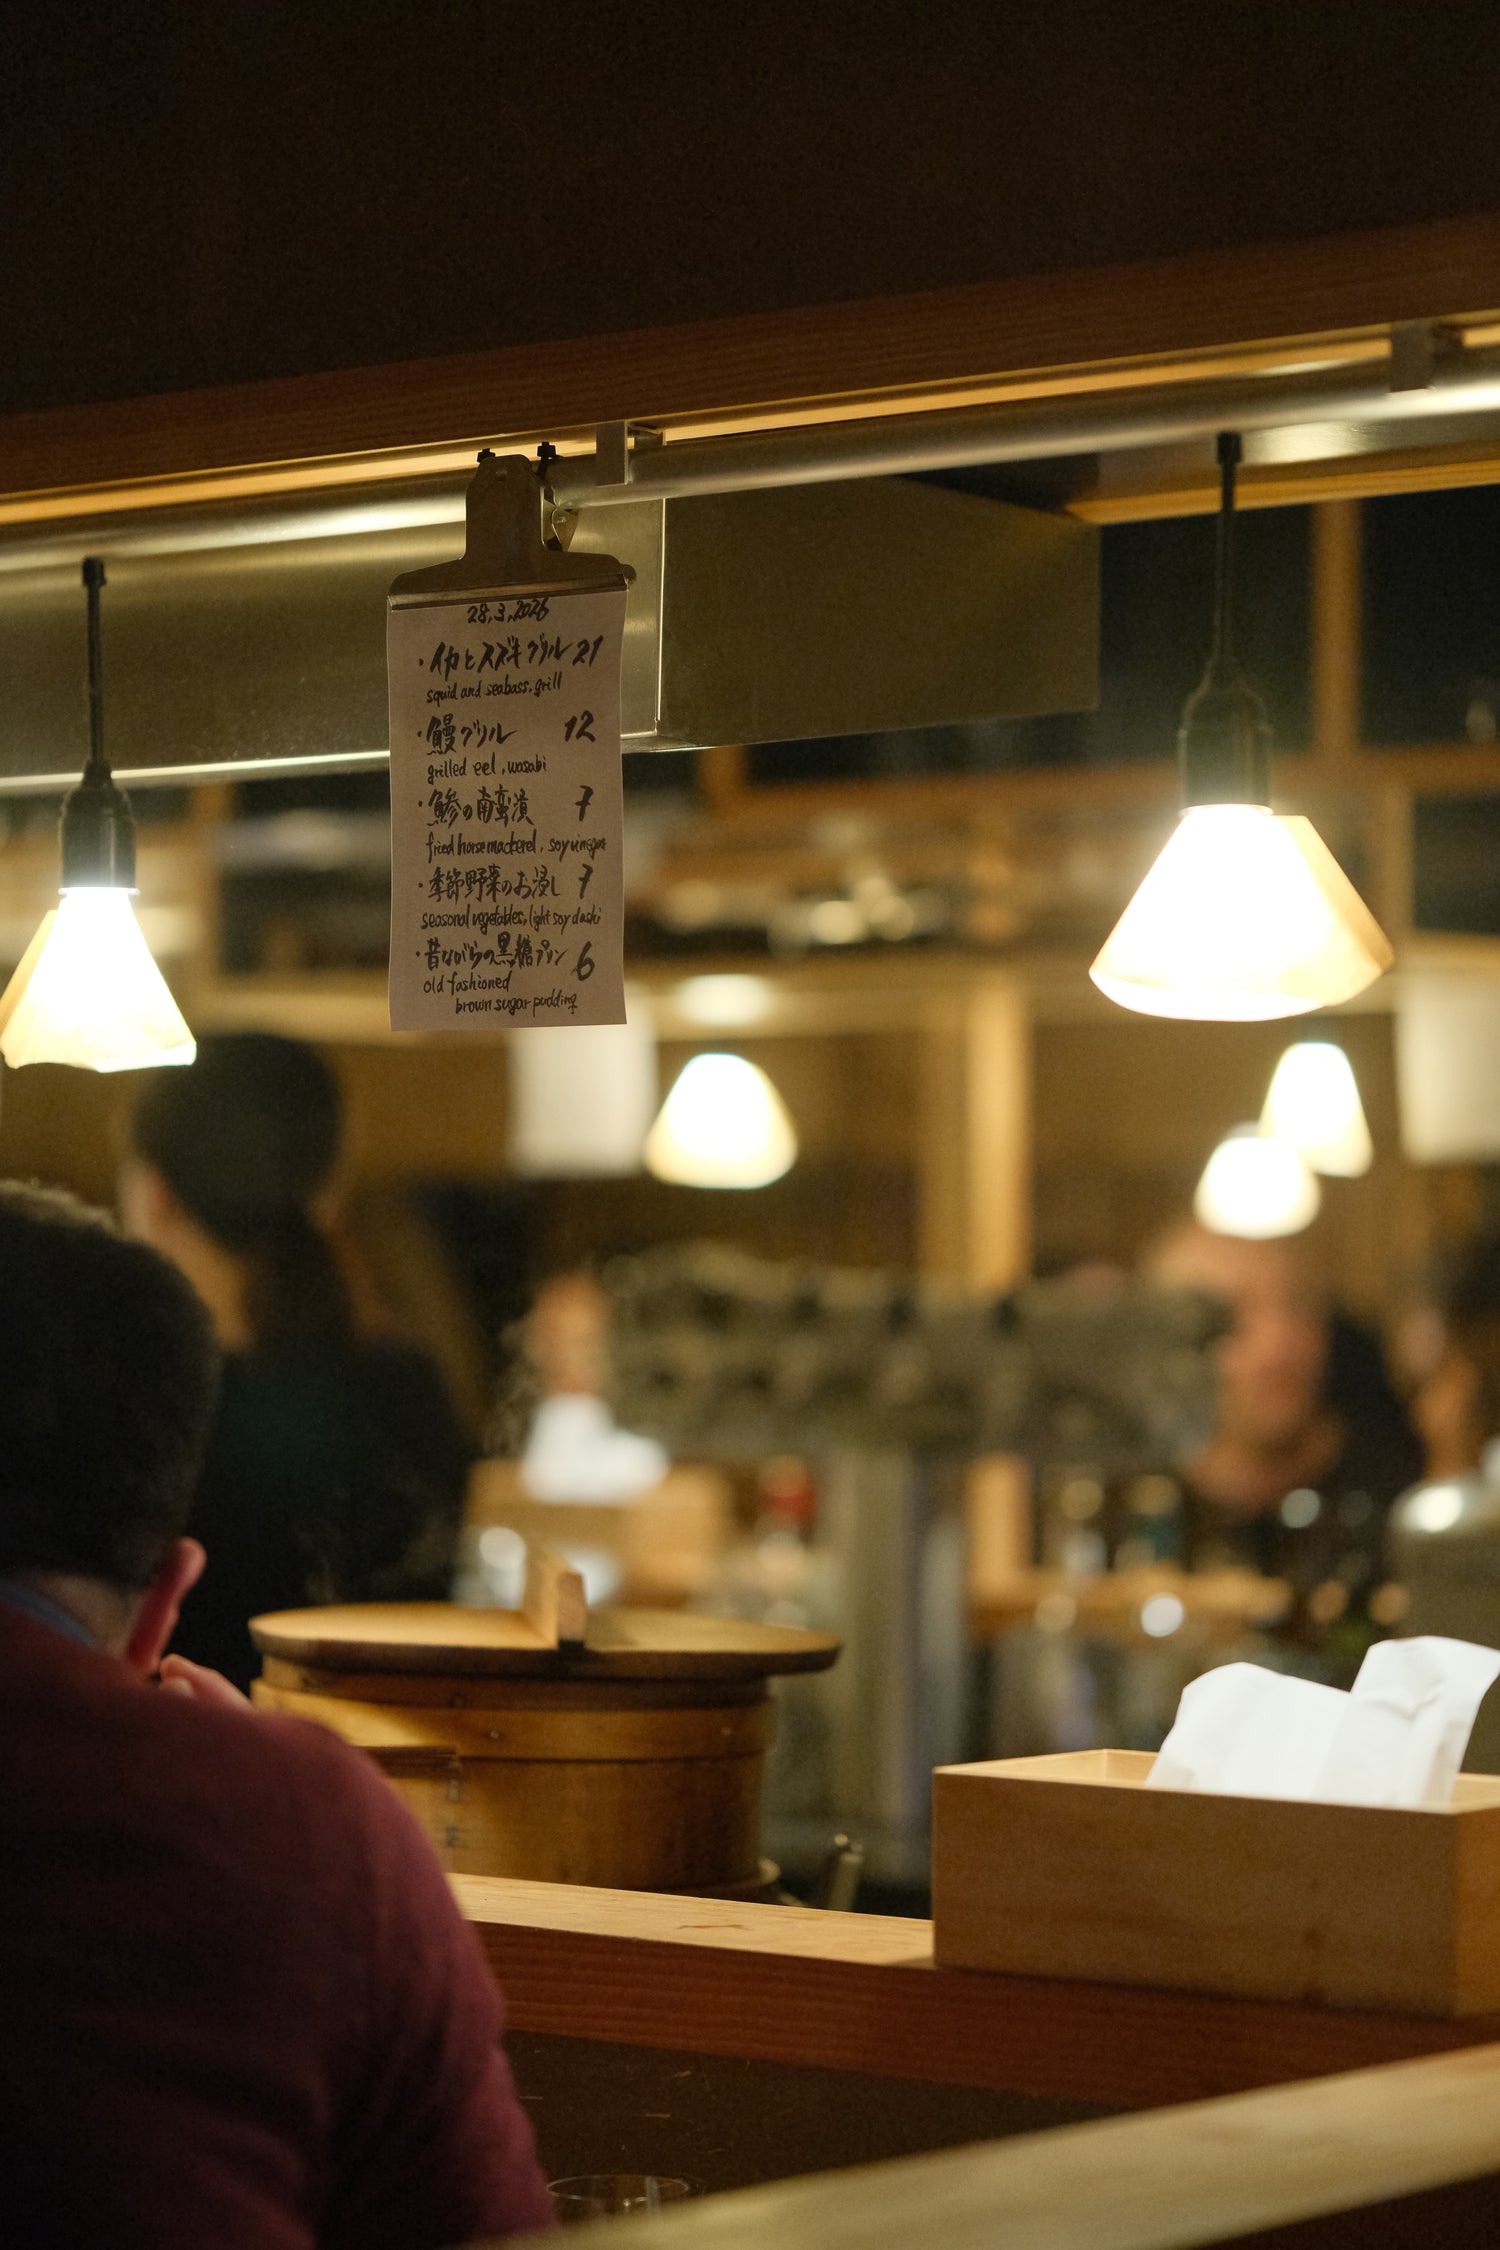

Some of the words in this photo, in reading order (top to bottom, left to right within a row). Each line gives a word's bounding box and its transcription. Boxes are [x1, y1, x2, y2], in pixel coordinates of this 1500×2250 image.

[572, 634, 604, 667] 21
[426, 685, 457, 707] squid
[460, 680, 481, 698] and
[534, 671, 562, 698] grill
[426, 712, 518, 756] 鰻グリル
[564, 709, 596, 742] 12
[427, 757, 467, 785] grilled
[574, 785, 594, 822] 7
[426, 831, 454, 864] fried
[578, 863, 594, 899] 7
[420, 904, 471, 929] seasonal
[529, 904, 551, 933] light
[553, 913, 571, 935] soy
[570, 941, 596, 981] 6
[423, 975, 444, 994] old
[447, 971, 513, 995] fashioned
[455, 997, 491, 1014] brown
[493, 997, 530, 1016] sugar
[532, 989, 578, 1018] pudding
